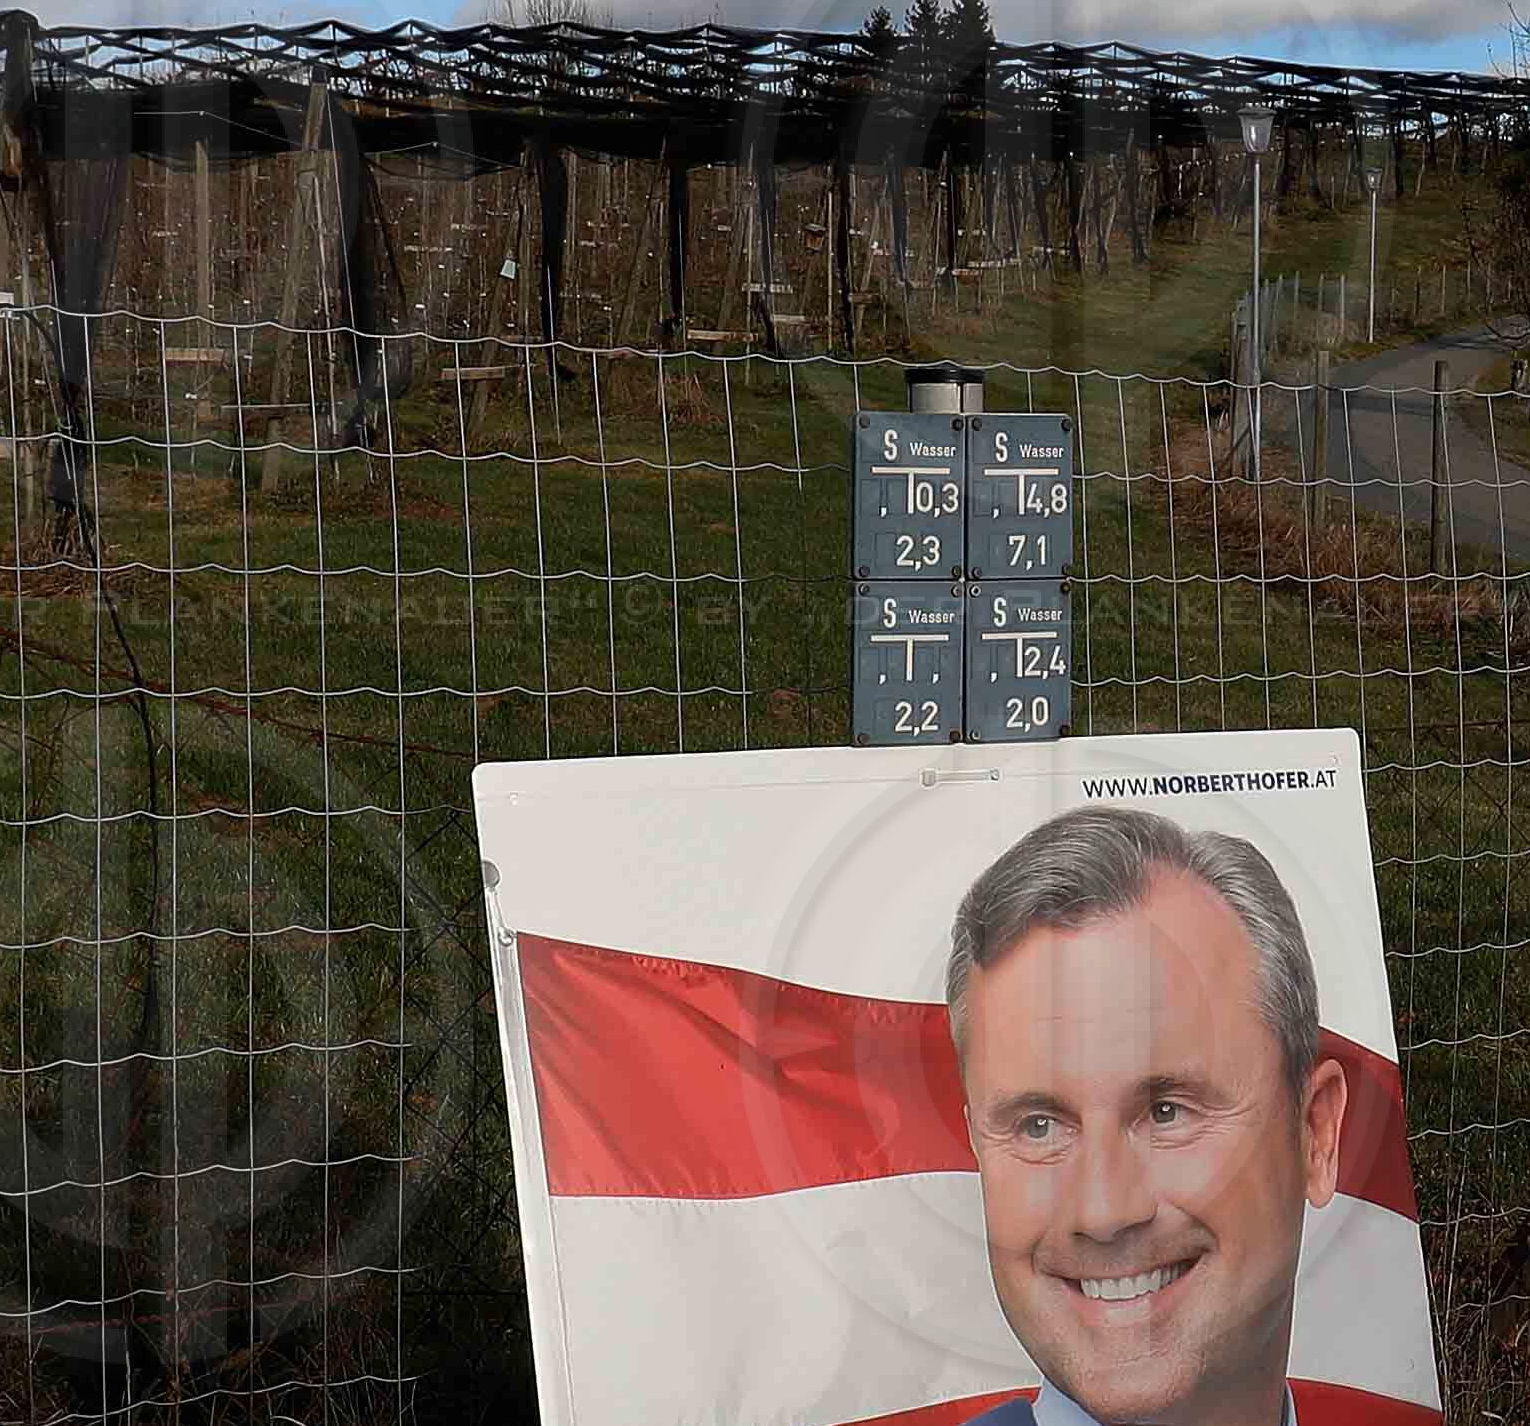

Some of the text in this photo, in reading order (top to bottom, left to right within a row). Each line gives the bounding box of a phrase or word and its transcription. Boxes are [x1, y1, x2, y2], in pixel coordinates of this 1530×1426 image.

[884, 429, 957, 461] S Wasser
[995, 431, 1064, 463] S Wasser
[896, 535, 940, 571] 2,3
[1009, 535, 1047, 570] 7,1
[883, 598, 955, 629] S Wasser
[994, 597, 1063, 627] S Wasser
[895, 702, 939, 737] 2,2
[1007, 697, 1049, 731] 2,0
[1082, 768, 1338, 800] WWW.NORBERTHOFER.AT
